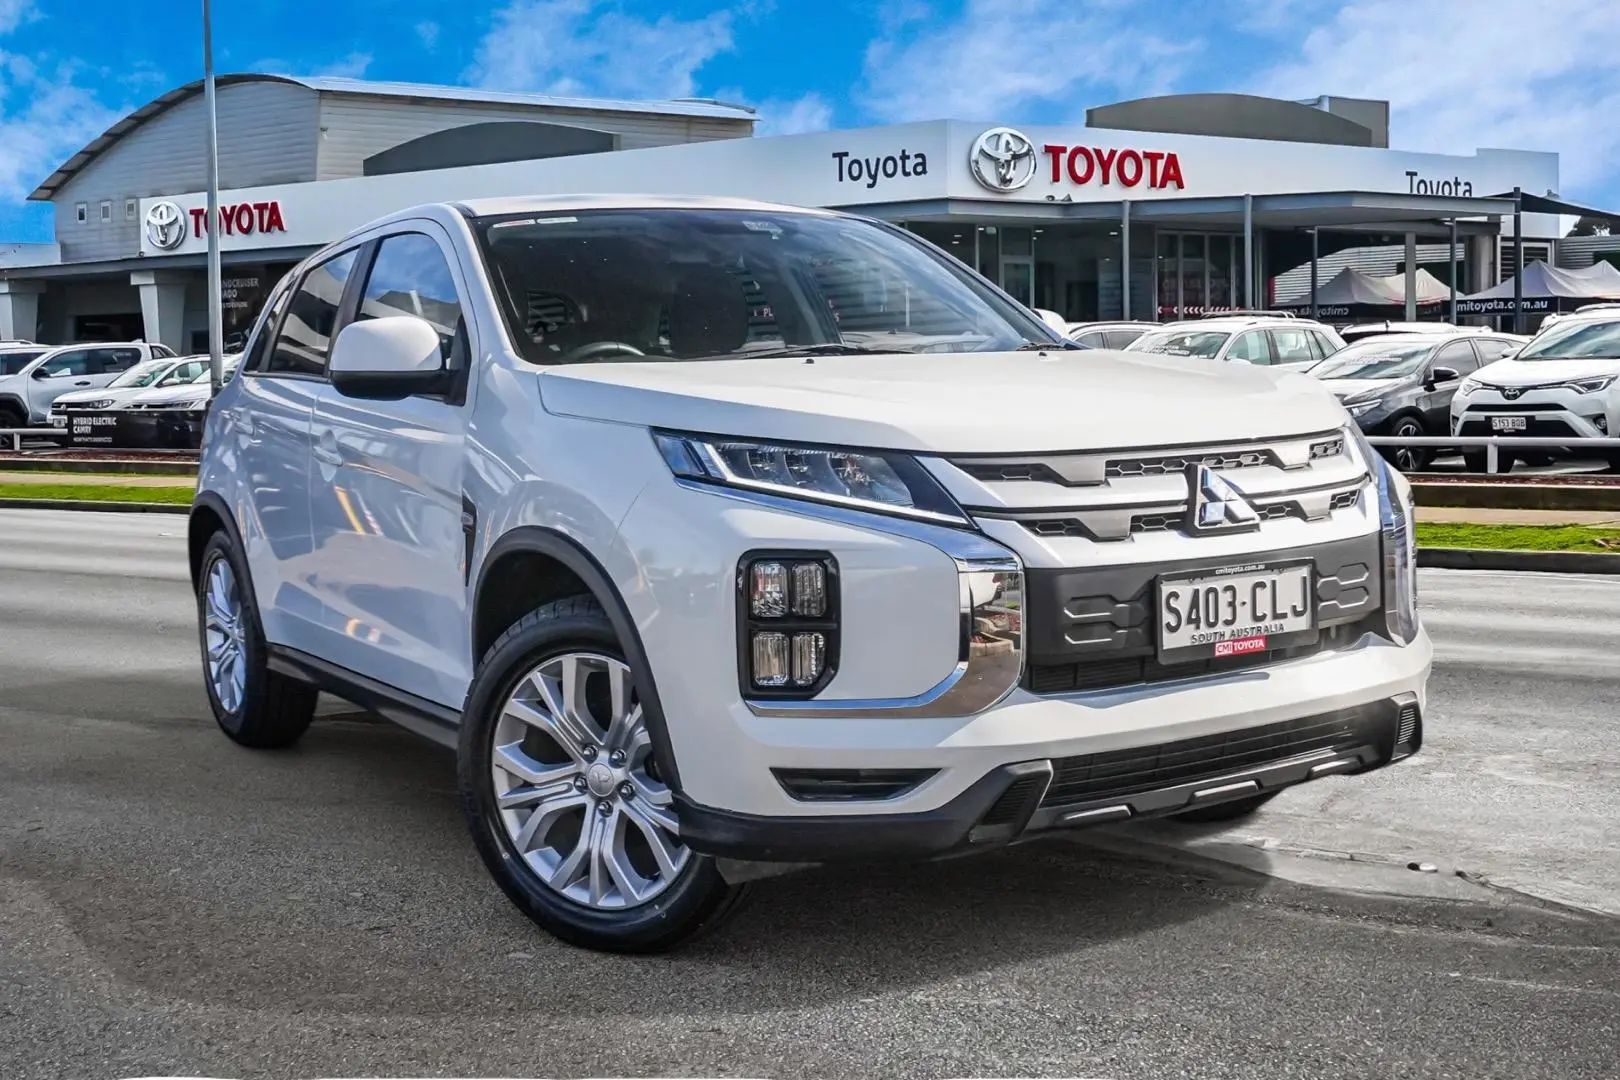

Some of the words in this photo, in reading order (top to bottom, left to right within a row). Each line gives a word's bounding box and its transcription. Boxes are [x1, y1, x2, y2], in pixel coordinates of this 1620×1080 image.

[832, 149, 927, 188] Toyota
[1044, 144, 1184, 189] TOYOTA
[1215, 564, 1265, 575] cmitoyota.com.au
[1191, 631, 1226, 644] SOUTH
[1230, 623, 1285, 638] AUSTRALIA
[1233, 638, 1265, 652] TOYOTA
